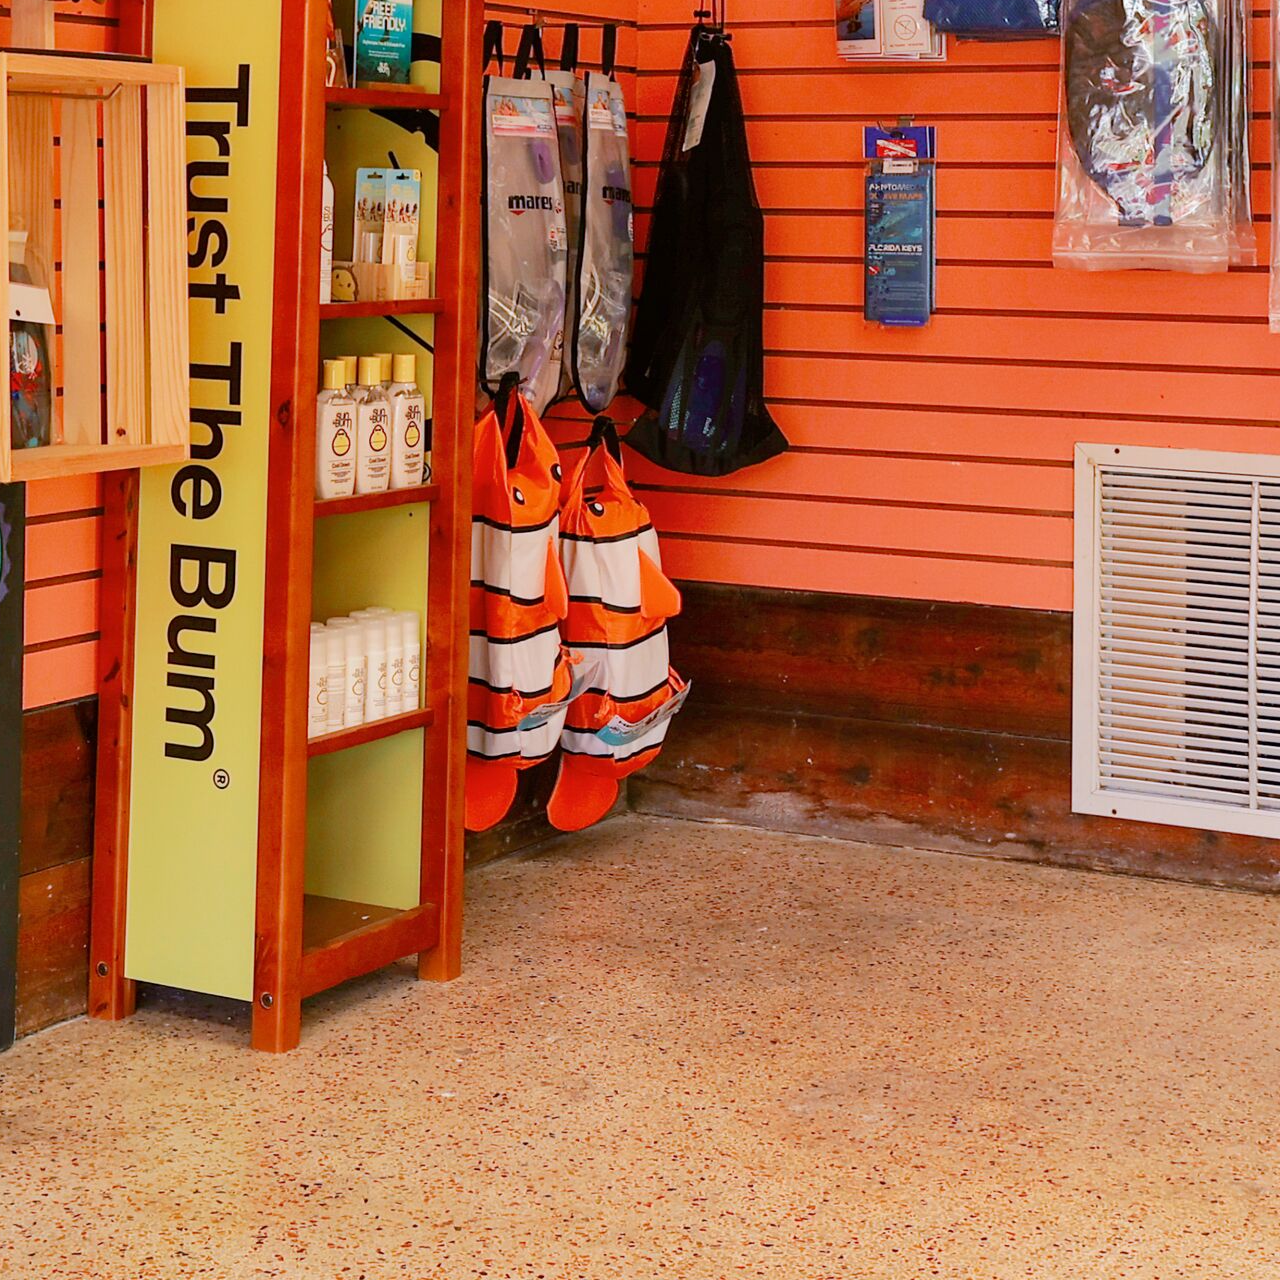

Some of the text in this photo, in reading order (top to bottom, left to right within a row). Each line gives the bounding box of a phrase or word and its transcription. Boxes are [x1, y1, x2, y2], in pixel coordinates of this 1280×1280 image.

[373, 1, 397, 16] REEF
[363, 15, 407, 32] FRIENDLY
[186, 64, 251, 314] Trust
[902, 244, 923, 252] KEYS
[170, 341, 242, 520] The
